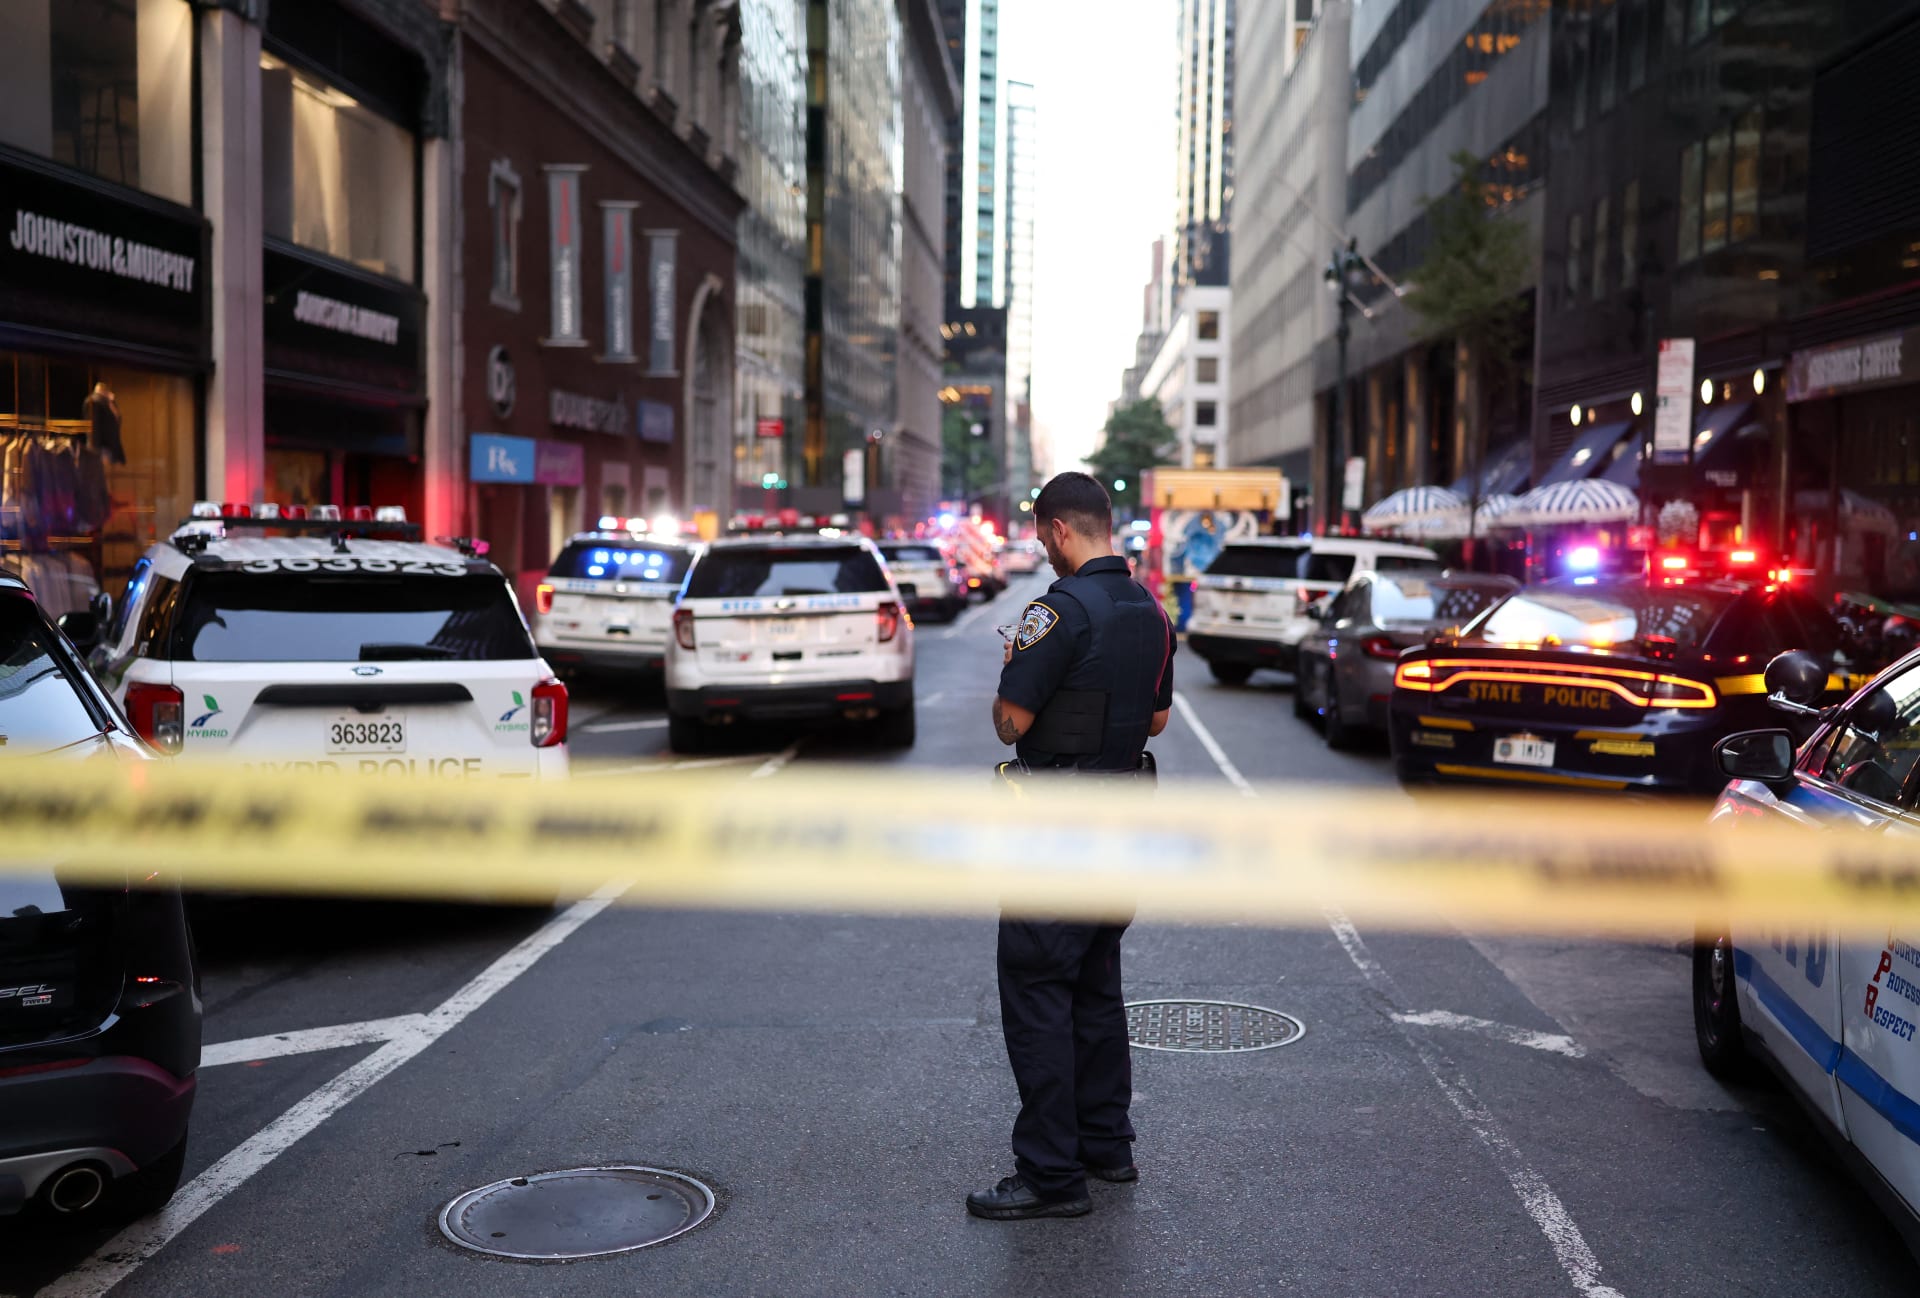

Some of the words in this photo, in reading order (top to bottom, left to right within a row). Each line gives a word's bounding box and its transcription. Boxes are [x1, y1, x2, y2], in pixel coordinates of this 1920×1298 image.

[11, 209, 112, 273] JOHNSTON
[127, 240, 195, 293] MURPHY
[1468, 681, 1523, 703] STATE
[1543, 685, 1612, 710] POLICE
[186, 728, 228, 739] HYBRID
[331, 723, 403, 744] 363823
[494, 722, 530, 732] HYBRID
[1863, 983, 1917, 1042] RESPECT
